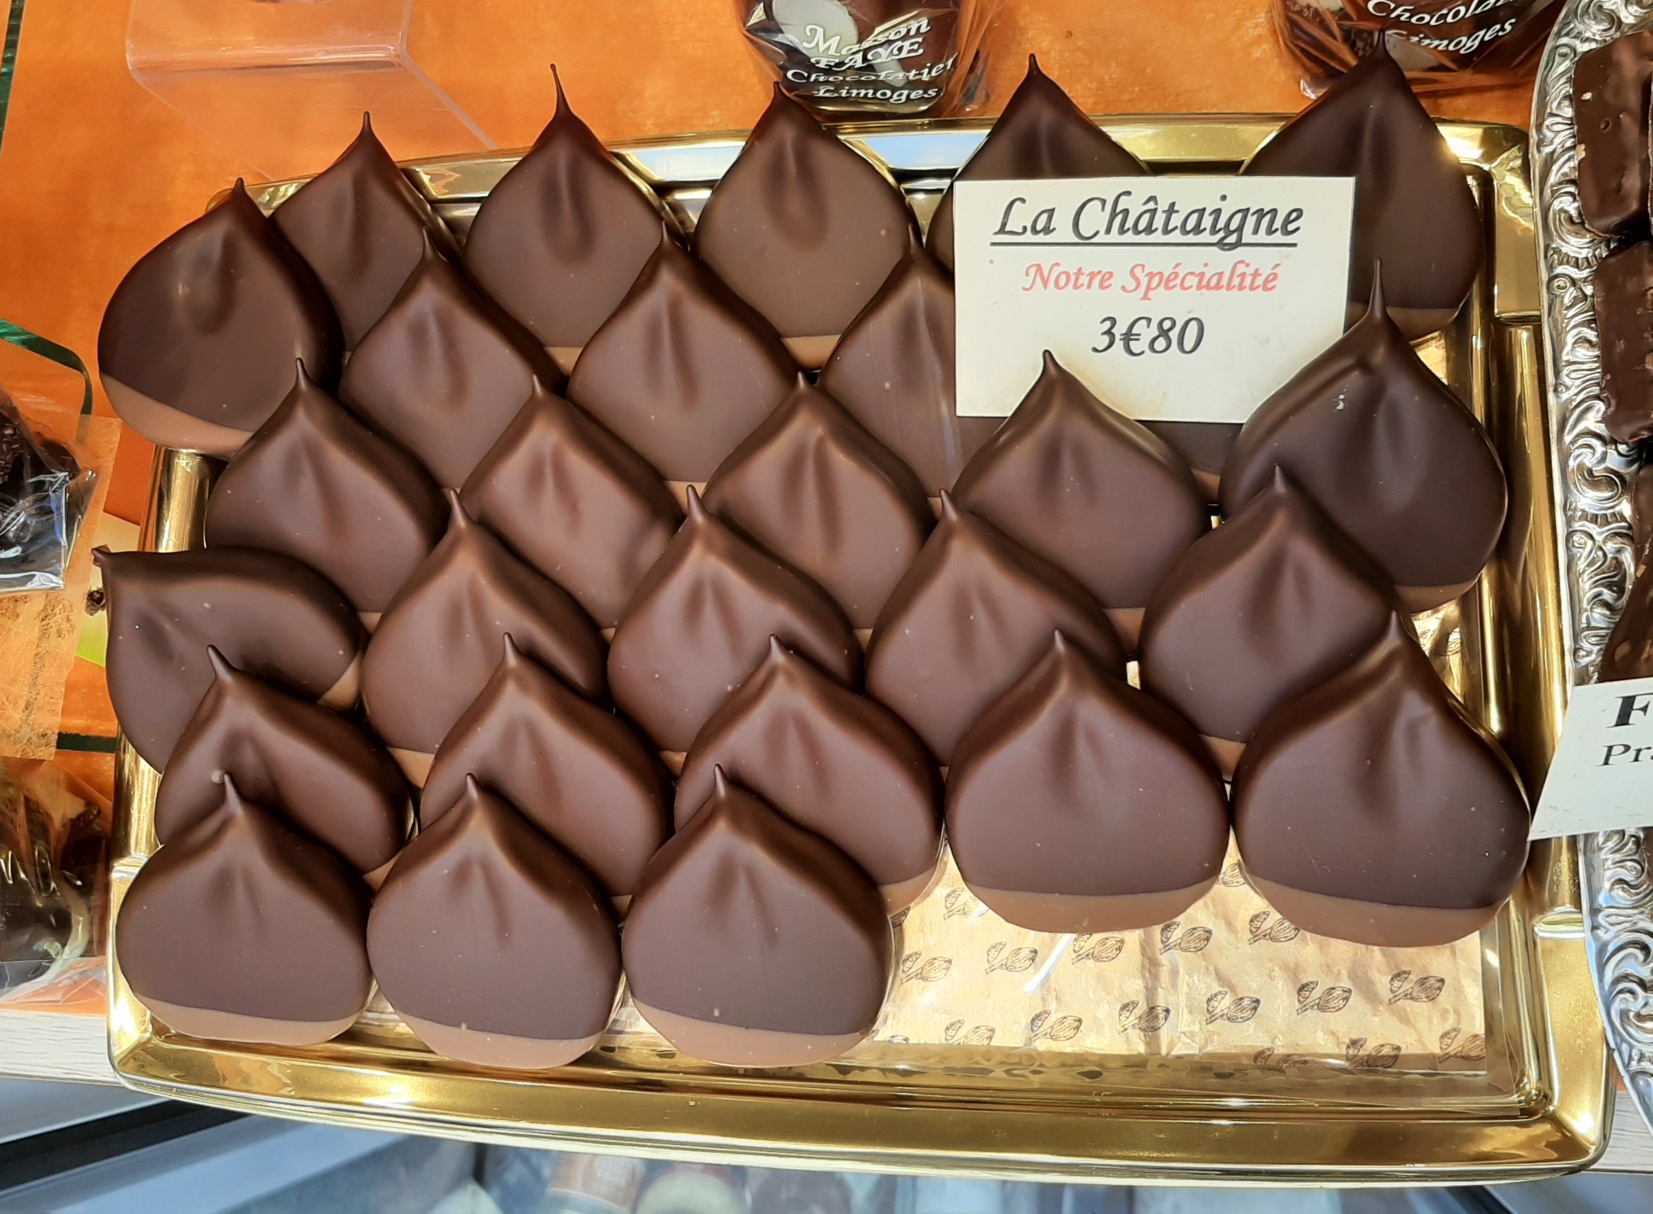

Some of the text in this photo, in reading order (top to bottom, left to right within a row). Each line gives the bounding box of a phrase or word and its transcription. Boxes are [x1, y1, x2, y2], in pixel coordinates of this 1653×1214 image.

[1367, 0, 1514, 26] Chocola
[810, 37, 924, 71] FAYE
[814, 85, 939, 104] Limoges
[993, 190, 1304, 251] La Châtaigne
[1021, 260, 1282, 300] Notre Spécialité
[1091, 316, 1205, 357] 3€80
[1596, 743, 1653, 767] Pr
